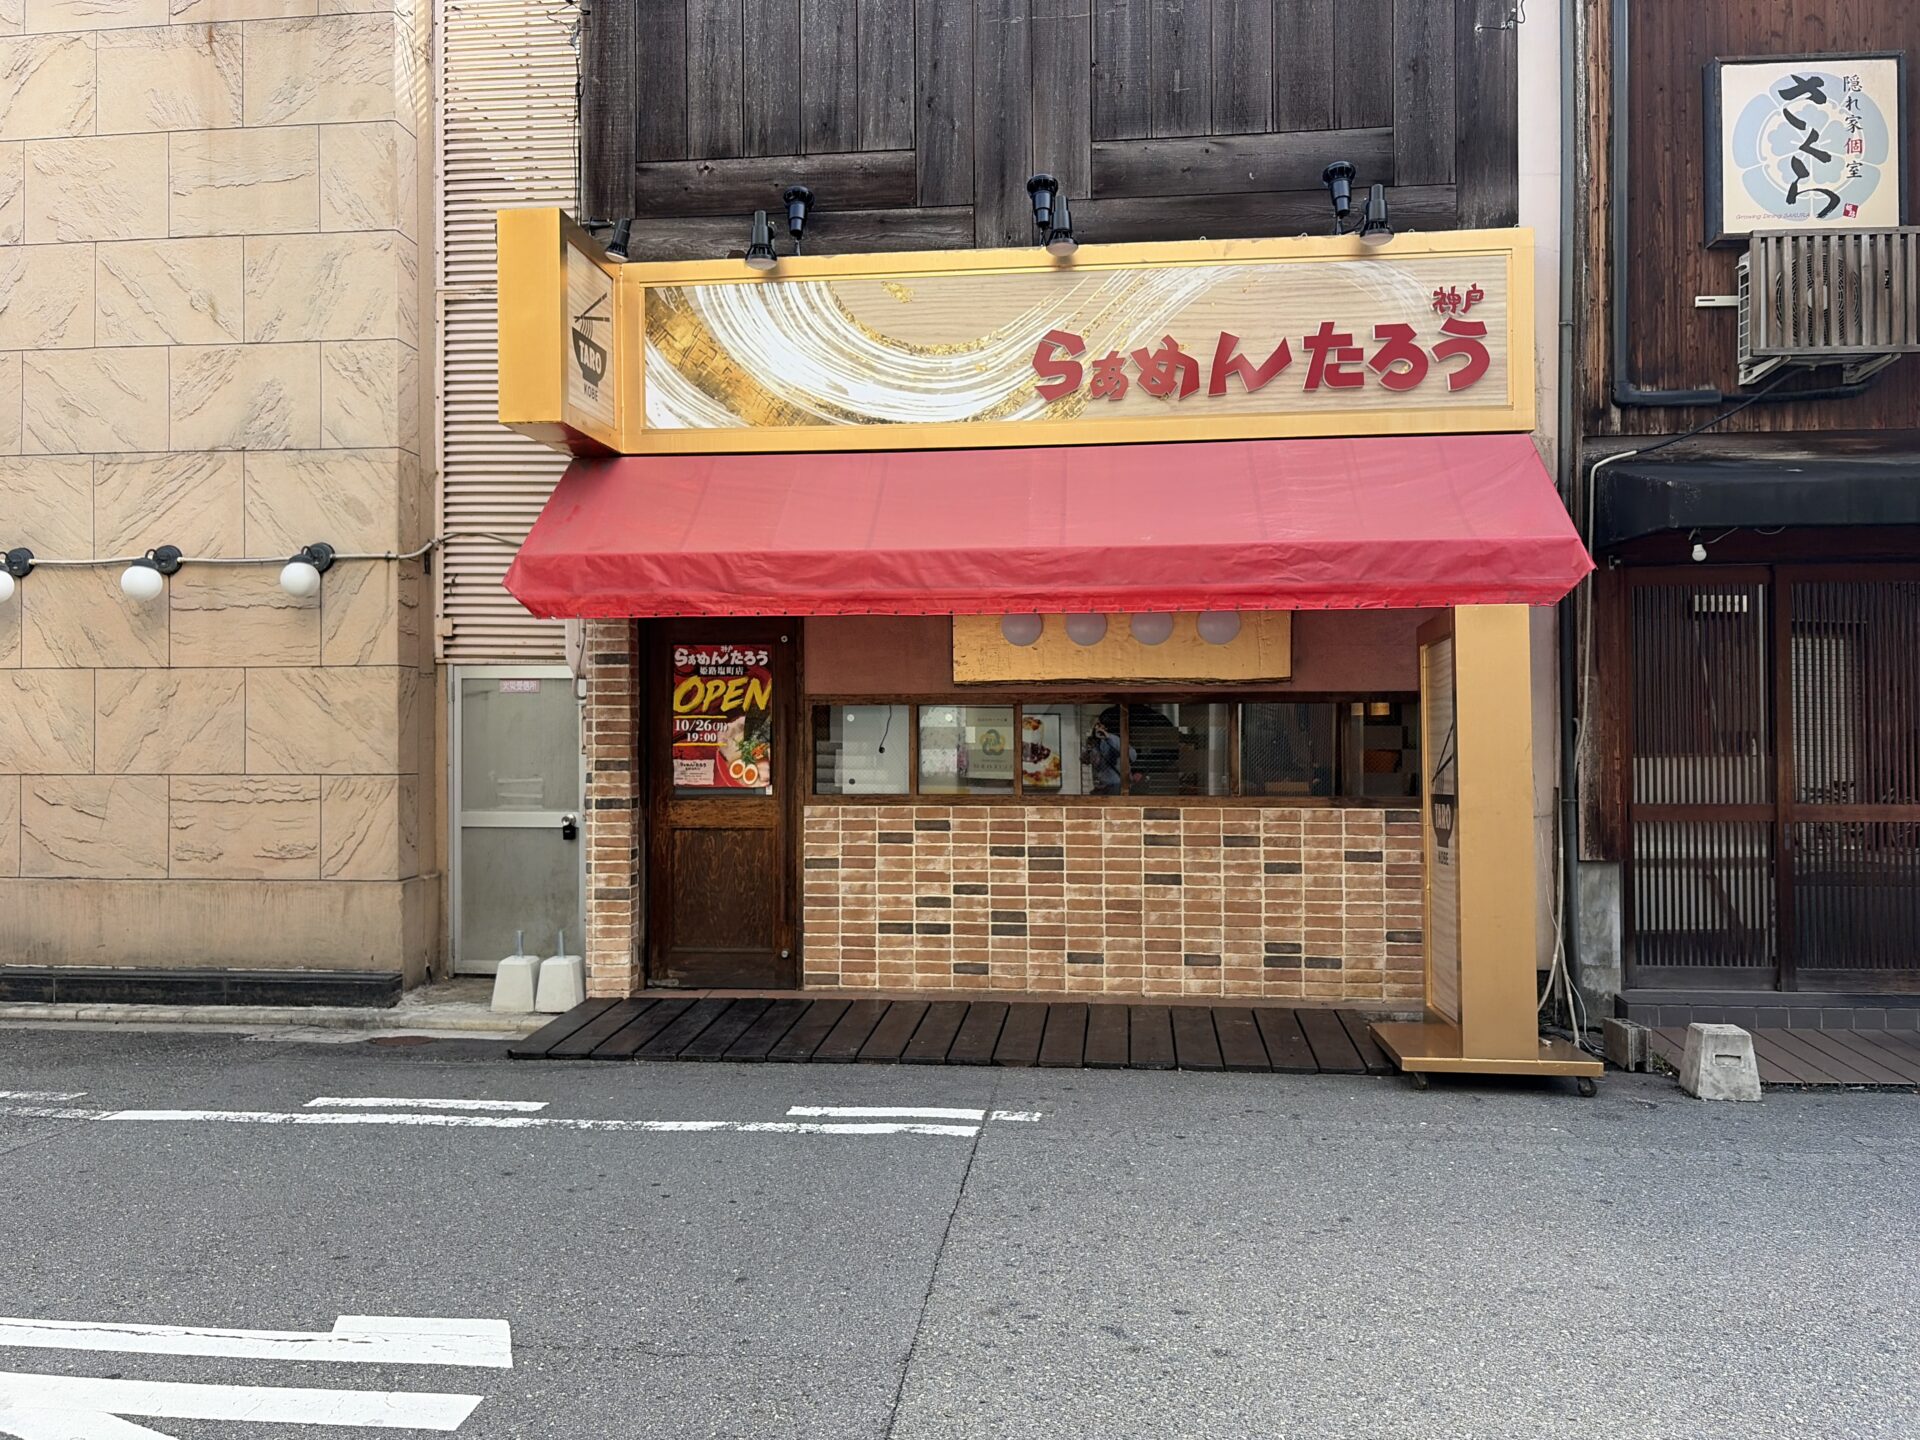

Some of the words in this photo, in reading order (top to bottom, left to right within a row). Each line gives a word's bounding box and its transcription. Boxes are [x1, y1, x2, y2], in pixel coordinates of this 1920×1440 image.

[1843, 74, 1863, 179] 隠れ家個室
[1778, 74, 1841, 218] さくら
[1431, 283, 1484, 316] 神戸
[579, 340, 602, 374] TARO
[1031, 317, 1492, 403] らぁめんたろう
[584, 383, 599, 402] KOBE
[699, 666, 744, 676] 姫路塩町店
[673, 674, 772, 713] OPEN
[687, 732, 717, 742] 19:00
[1434, 803, 1451, 830] TARO
